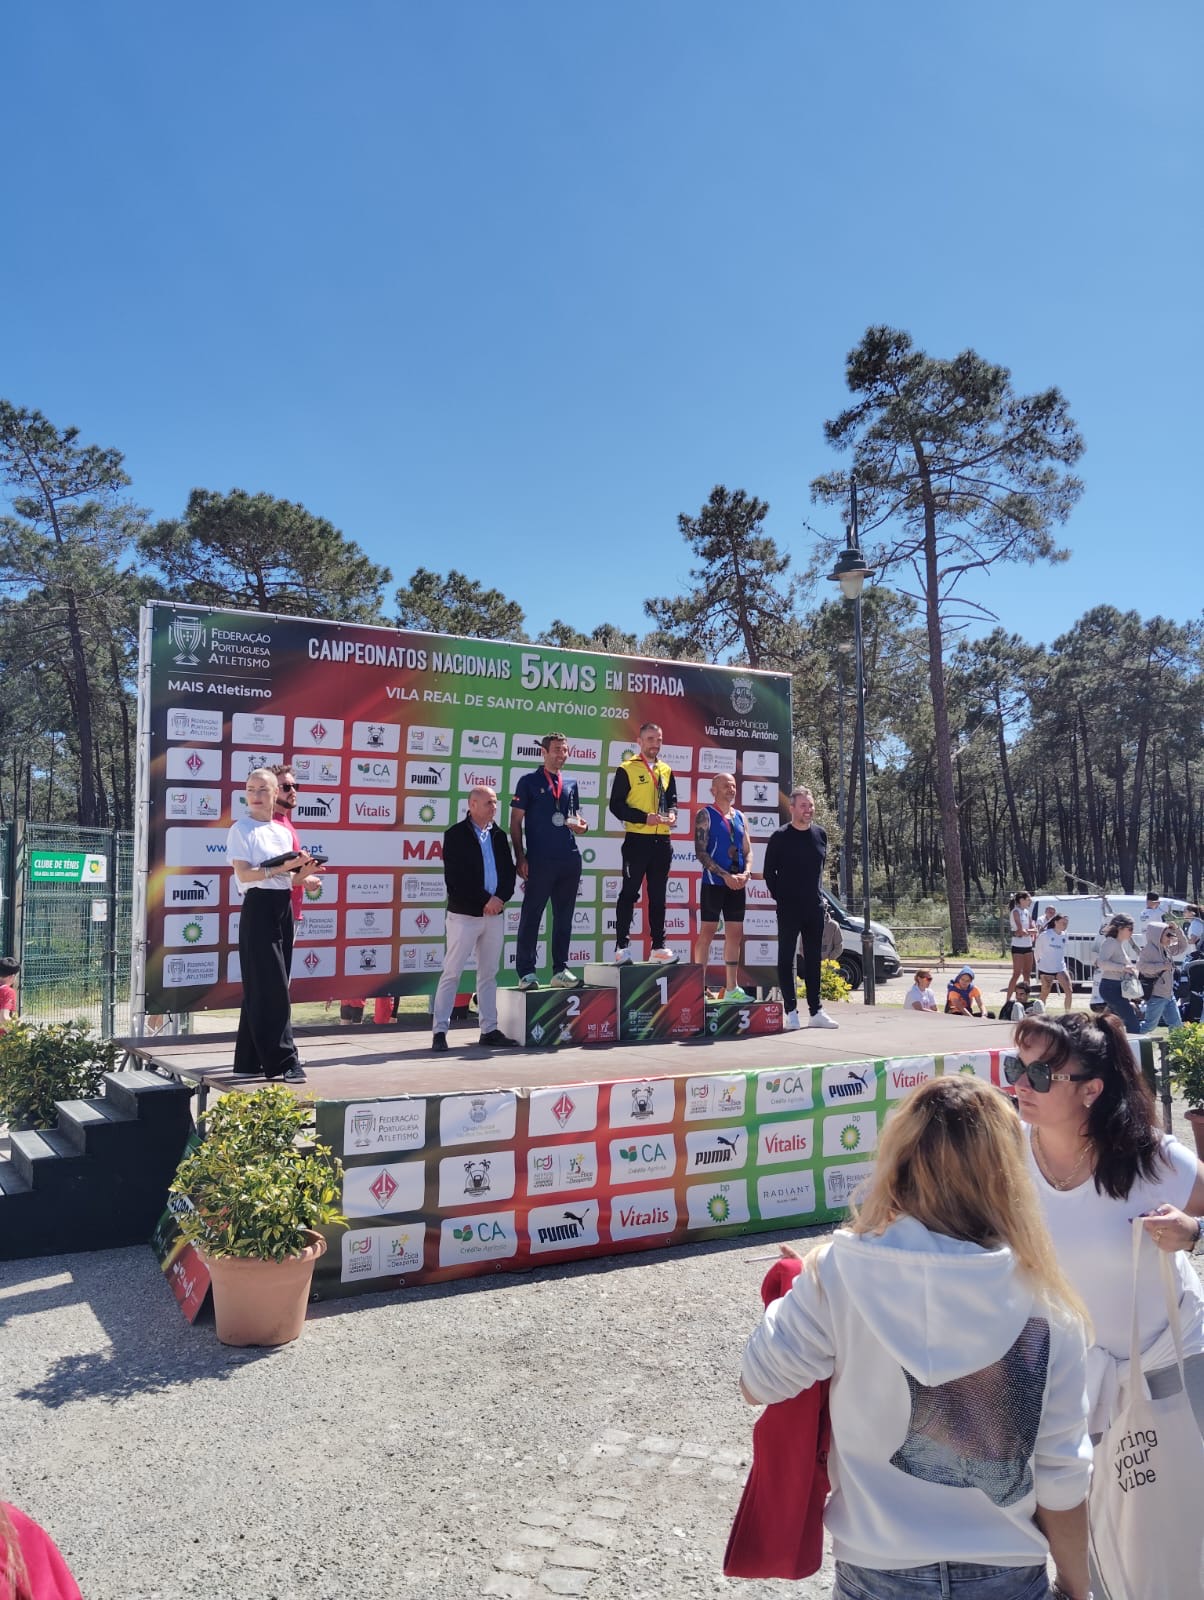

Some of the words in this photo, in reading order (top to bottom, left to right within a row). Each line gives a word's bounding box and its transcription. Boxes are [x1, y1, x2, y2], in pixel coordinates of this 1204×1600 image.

[211, 627, 271, 644] FEDERAÇÃO
[211, 641, 271, 656] PORTUGUESA
[208, 653, 270, 668] ATLETISMO
[308, 637, 427, 671] CAMPEONATOS
[432, 651, 511, 680] NACIONAIS
[520, 653, 596, 692] 5KMS
[605, 670, 623, 691] EM
[627, 672, 685, 697] ESTRADA
[168, 680, 204, 693] MAIS
[207, 683, 272, 698] Atletismo
[385, 686, 420, 701] VILA
[424, 690, 461, 705] REAL
[464, 693, 484, 707] DE
[486, 695, 533, 711] SANTO
[536, 699, 597, 717] ANTÓNIO
[600, 706, 630, 720] 2026
[705, 726, 718, 736] Vila
[719, 727, 735, 737] Real
[751, 729, 779, 740] António
[482, 736, 498, 748] CA
[517, 746, 541, 756] PUMA
[567, 744, 596, 759] Vitalis
[373, 764, 390, 776] CA
[411, 774, 437, 785] PUMA
[464, 772, 497, 786] Vitalis
[298, 806, 326, 817] PUMA
[355, 802, 390, 817] Vitalis
[760, 817, 775, 828] CA
[403, 840, 444, 860] MA
[54, 860, 62, 869] DE
[173, 889, 204, 900] PUMA
[668, 881, 684, 893] CA
[747, 885, 773, 899] Vital
[574, 912, 590, 923] CA
[665, 919, 685, 928] talis
[569, 950, 590, 961] talis
[656, 976, 668, 1005] 1
[567, 995, 580, 1016] 2
[738, 1010, 750, 1029] 3
[783, 1077, 804, 1094] CA
[828, 1081, 863, 1098] PUMA
[379, 1113, 419, 1125] FEDERAÇÃO
[378, 1124, 419, 1133] PORTUGUESA
[377, 1132, 419, 1142] ATLETISMO
[765, 1133, 806, 1154] Vitalis
[642, 1143, 667, 1163] CA
[695, 1148, 731, 1166] PUMA
[763, 1186, 810, 1199] RADIANT
[620, 1205, 669, 1227] Vitalis
[478, 1220, 506, 1242] CA
[538, 1223, 580, 1244] PUMA
[1114, 1448, 1151, 1479] your
[1118, 1468, 1157, 1493] vibe
